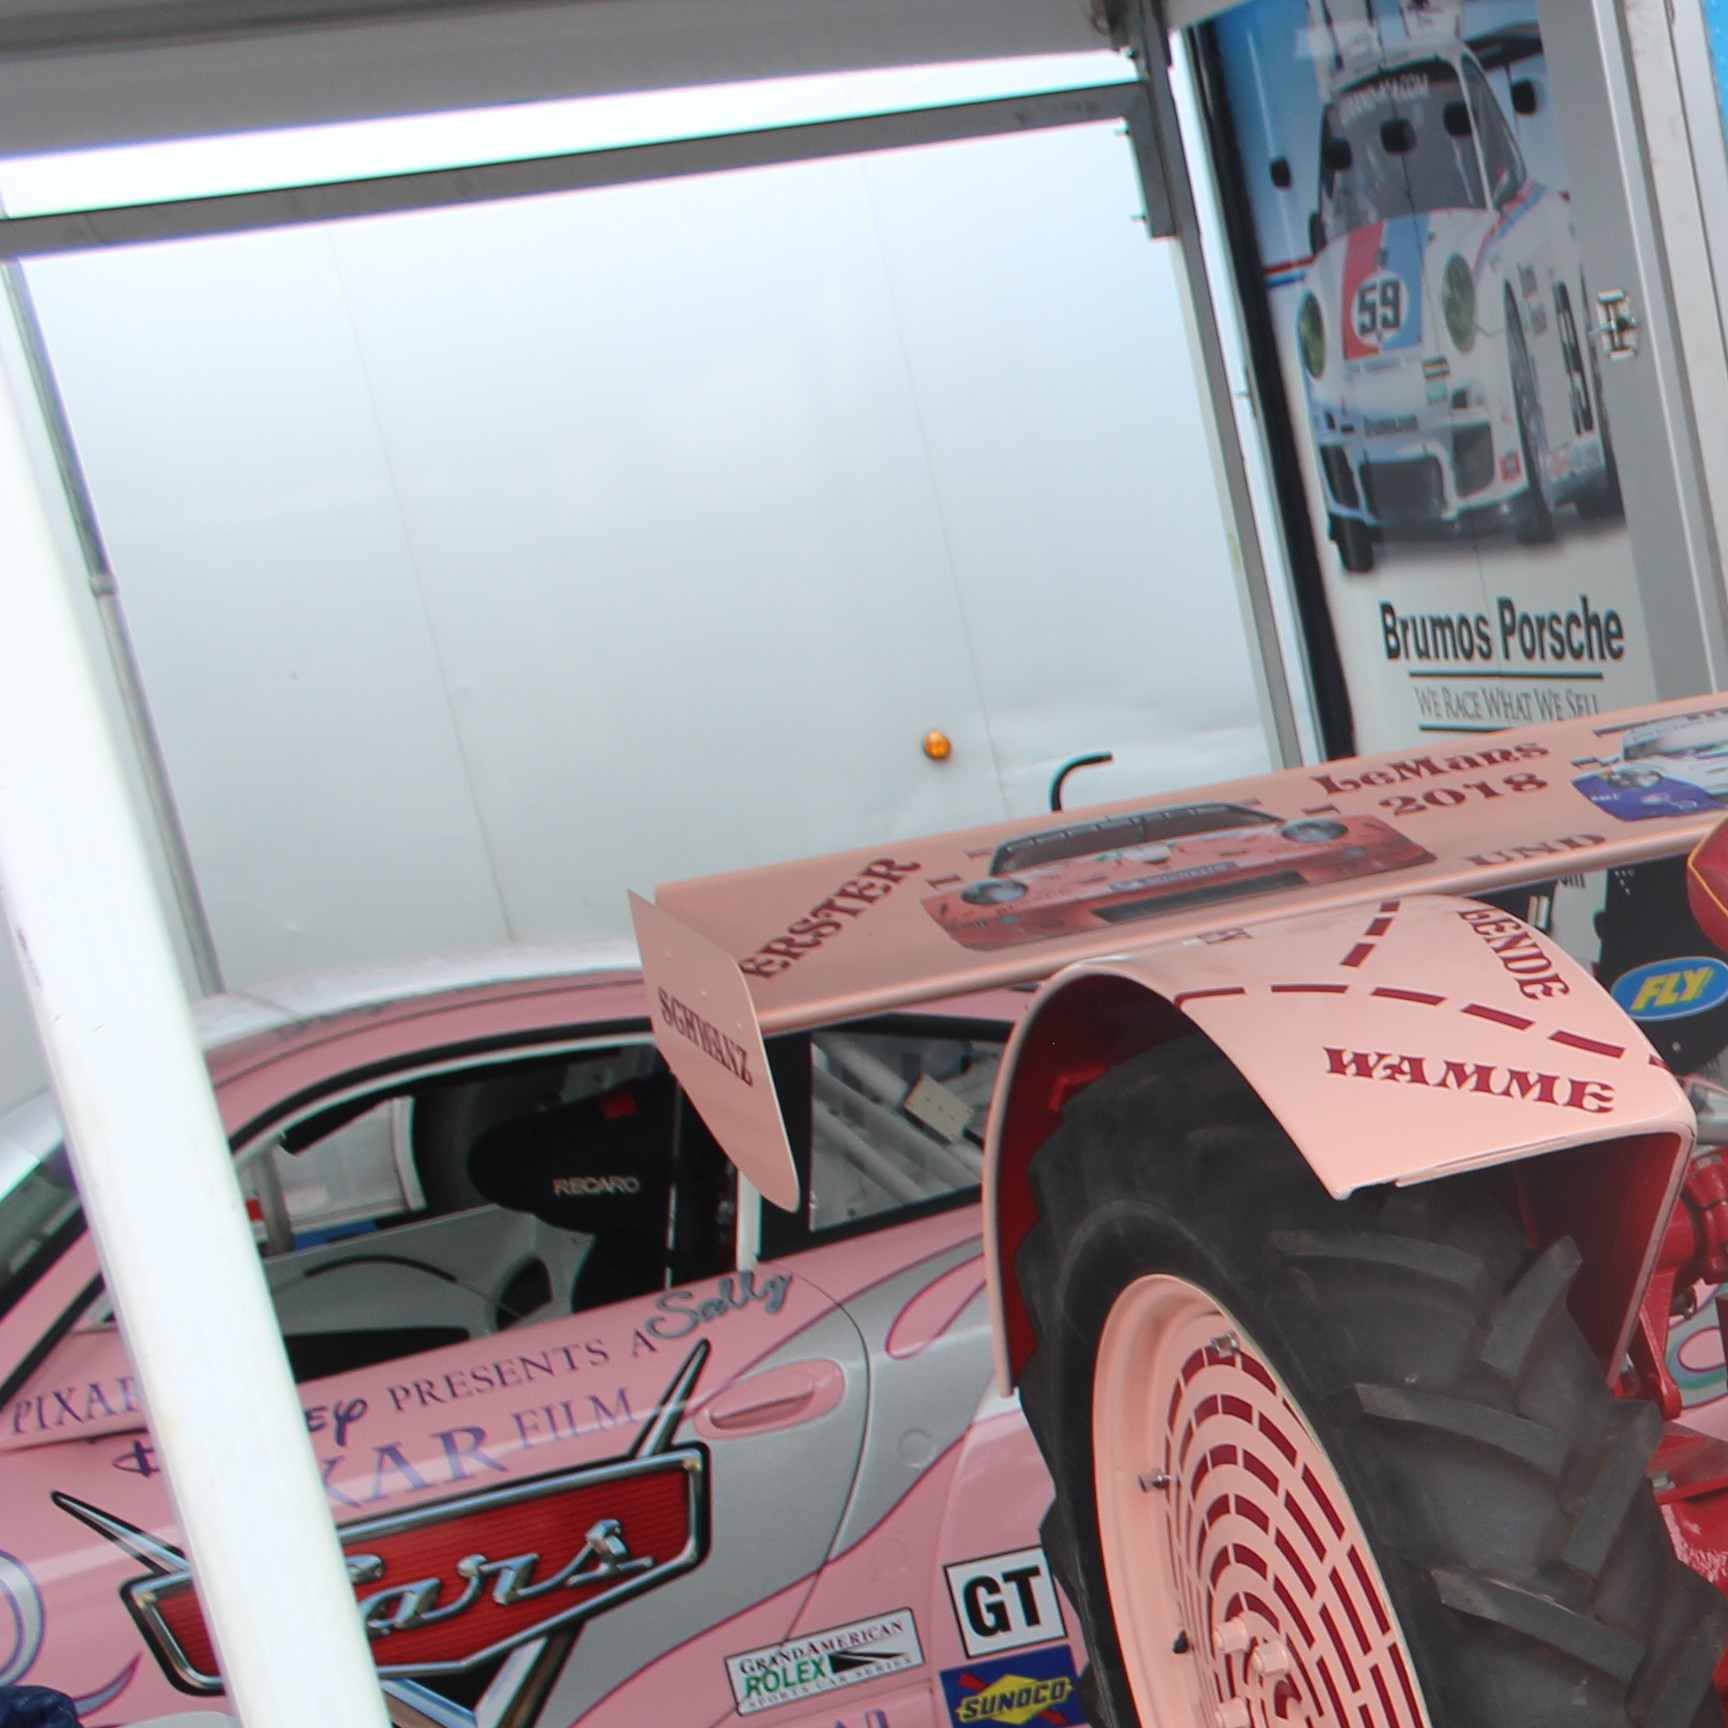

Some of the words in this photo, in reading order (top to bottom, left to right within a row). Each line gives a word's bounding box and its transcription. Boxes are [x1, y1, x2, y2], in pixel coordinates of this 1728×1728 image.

[1355, 280, 1401, 334] 59
[1380, 601, 1492, 660] Brumos
[1497, 594, 1625, 660] Porsche
[1377, 773, 1549, 816] 2018
[1461, 832, 1606, 866] UND
[740, 857, 921, 980] ERSTER
[1456, 907, 1570, 1000] LENDE
[1629, 967, 1714, 1011] FLY
[1322, 1046, 1616, 1114] WAMME
[554, 1176, 640, 1197] RECARO
[645, 1271, 794, 1340] Sally
[387, 1337, 609, 1412] PRESENTS
[631, 1328, 658, 1358] A
[512, 1387, 637, 1450] FILM
[963, 1564, 1042, 1638] GT
[745, 1657, 826, 1697] ROLEX
[962, 1679, 1070, 1720] SUNOCO
